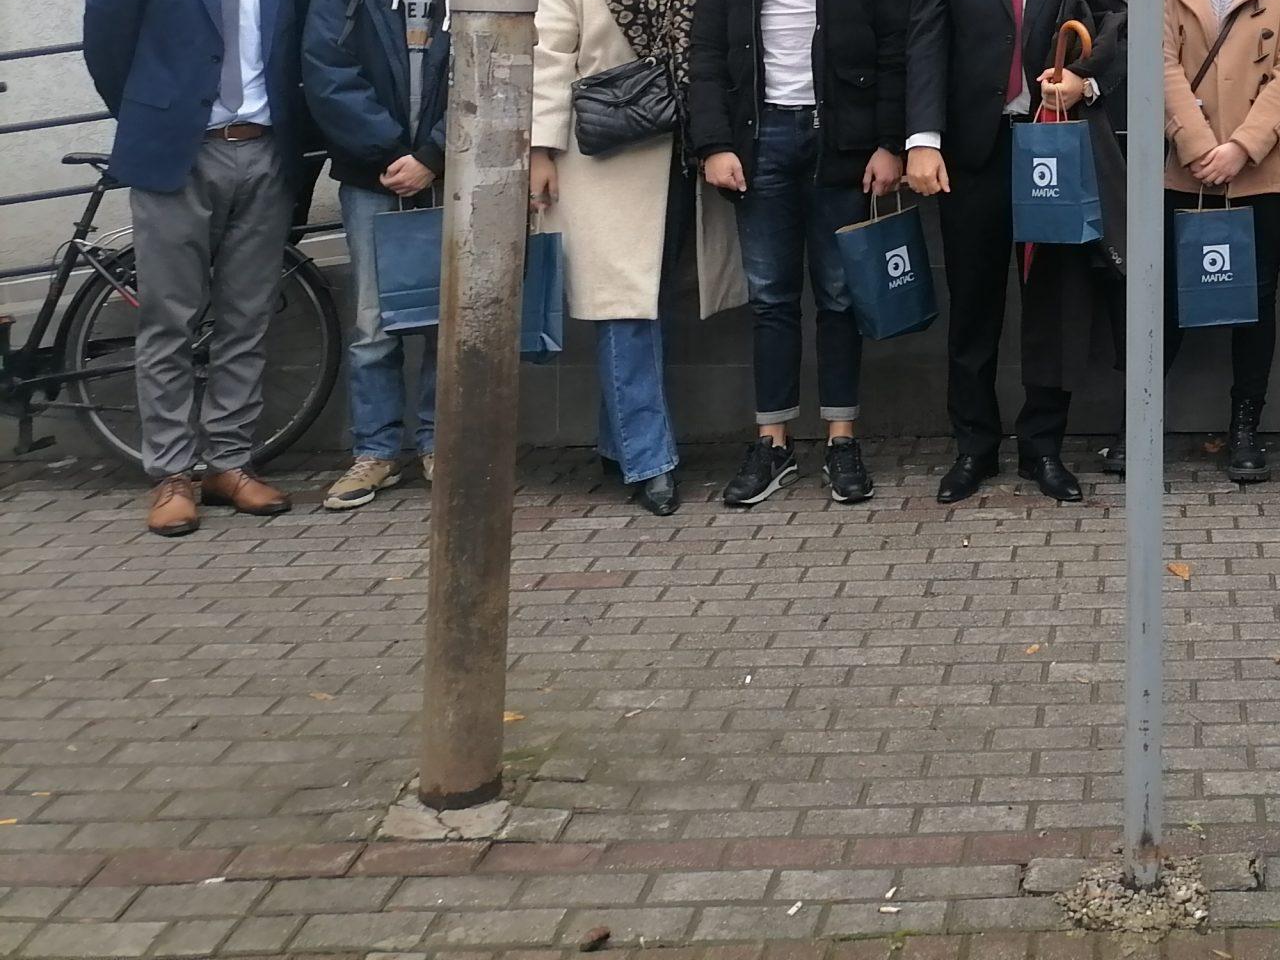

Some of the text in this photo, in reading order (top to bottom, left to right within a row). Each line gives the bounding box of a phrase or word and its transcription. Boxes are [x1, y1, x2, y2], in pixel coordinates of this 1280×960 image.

[1032, 187, 1060, 198] МАПАС
[889, 271, 915, 290] МАПАС
[1201, 272, 1235, 283] МАПАС
